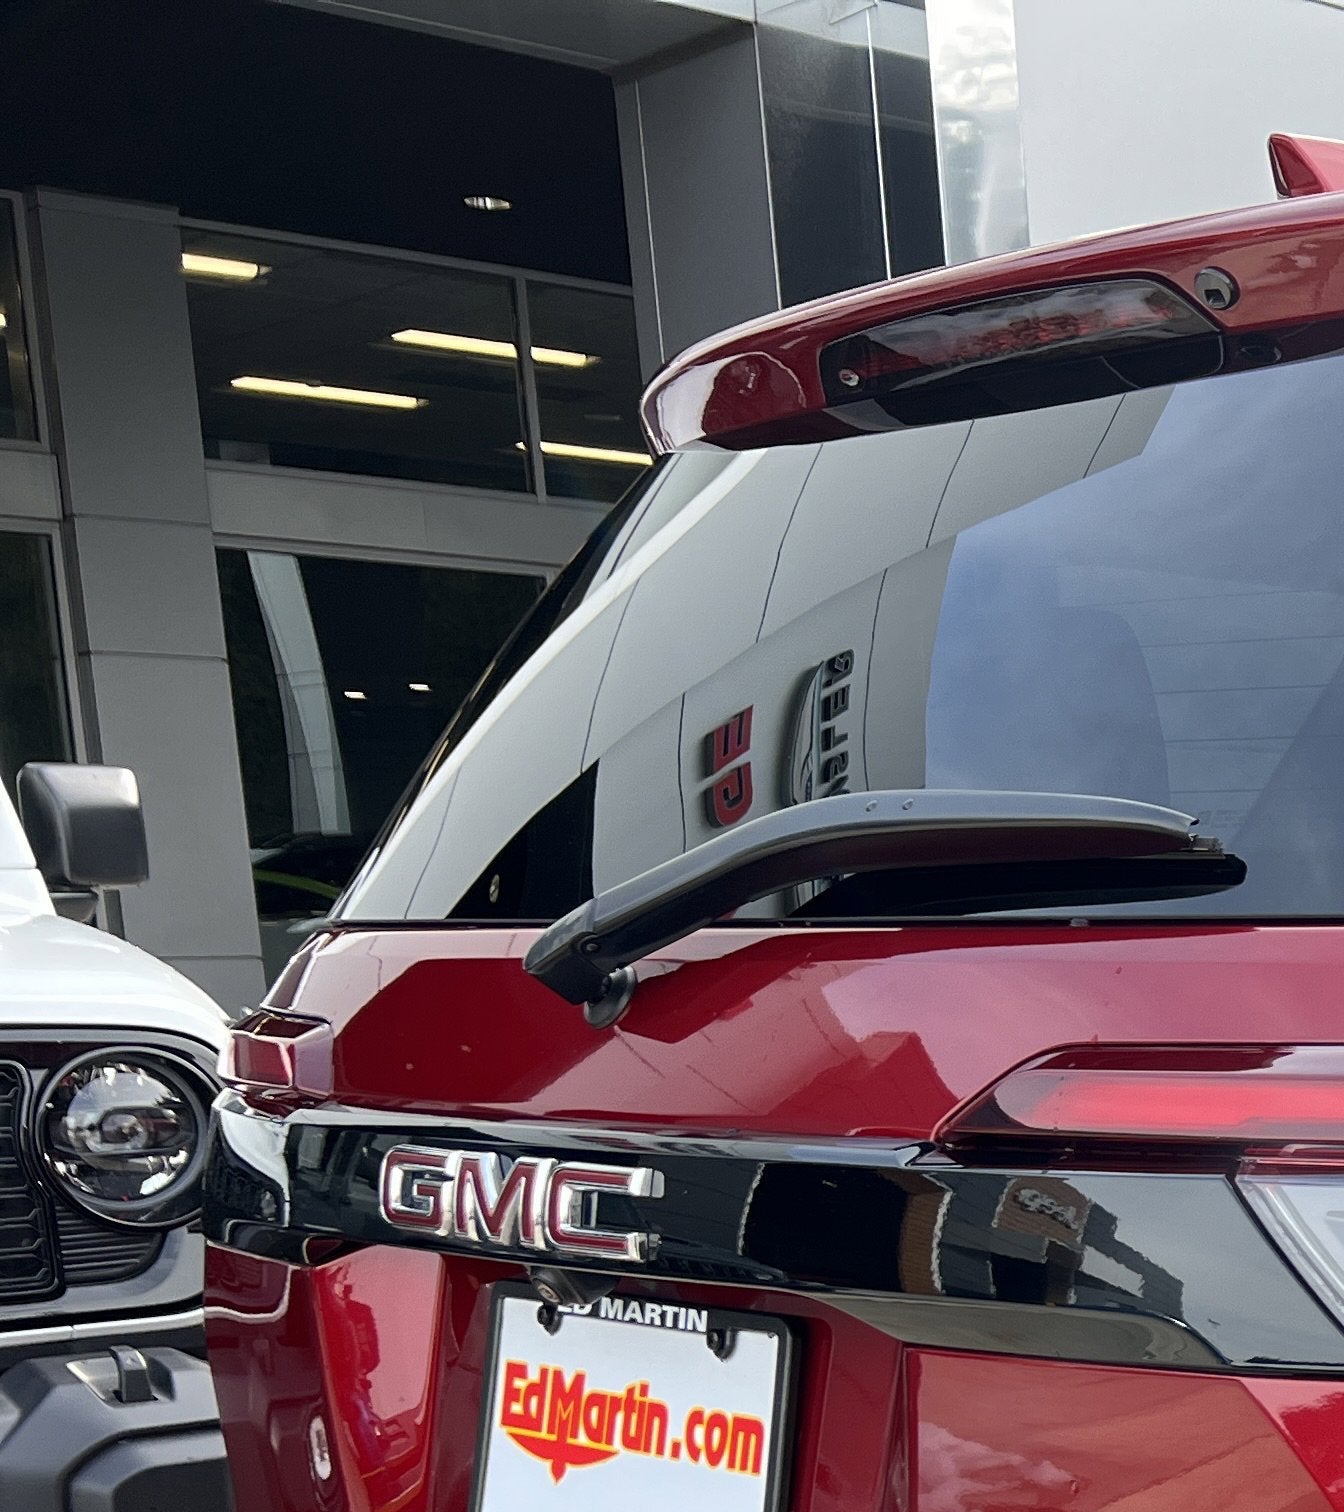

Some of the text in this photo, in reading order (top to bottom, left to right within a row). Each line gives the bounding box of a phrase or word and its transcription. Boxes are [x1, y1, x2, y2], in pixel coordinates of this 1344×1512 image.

[379, 1144, 664, 1263] GMC
[600, 1296, 708, 1333] MARTIN
[500, 1360, 766, 1476] EdMartin.com
